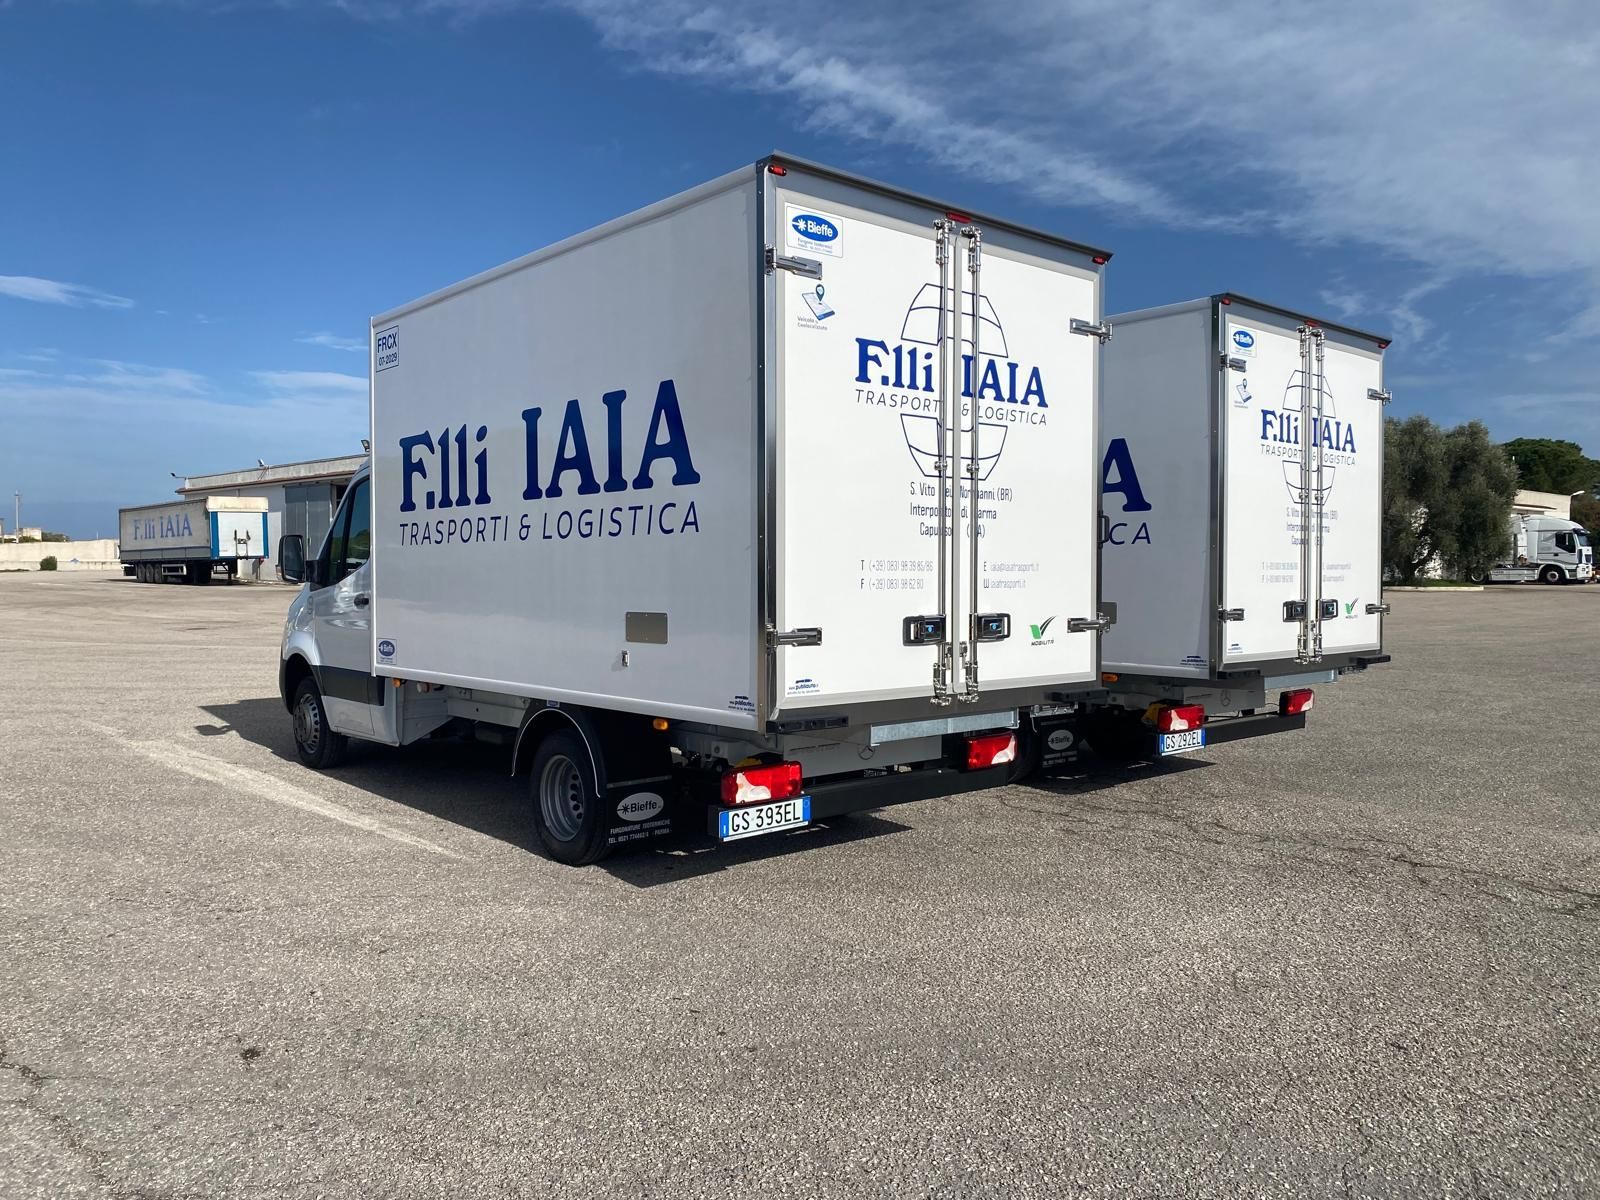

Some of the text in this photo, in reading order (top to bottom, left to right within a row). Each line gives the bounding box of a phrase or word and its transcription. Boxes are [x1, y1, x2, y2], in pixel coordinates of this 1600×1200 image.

[807, 220, 833, 237] Bieffe
[377, 332, 397, 353] FRCX
[855, 337, 1049, 408] F.lli IAIA
[856, 388, 944, 413] TRASPORT
[961, 403, 970, 417] &
[1261, 409, 1357, 453] F.lli IAIA
[399, 379, 700, 512] F.lli IAIA
[1261, 444, 1302, 459] TRASPORT
[1323, 453, 1356, 466] OGISTICA
[920, 481, 936, 497] Vito
[997, 486, 1013, 502] (BR)
[400, 501, 700, 546] TRASPORTI & LOGISTICA
[961, 505, 969, 519] di
[977, 509, 997, 520] arma
[160, 513, 193, 538] IAIA
[983, 578, 990, 589] W
[1165, 731, 1201, 750] GS 292EL
[631, 801, 657, 813] Bieffe
[732, 802, 801, 832] GS 393EL
